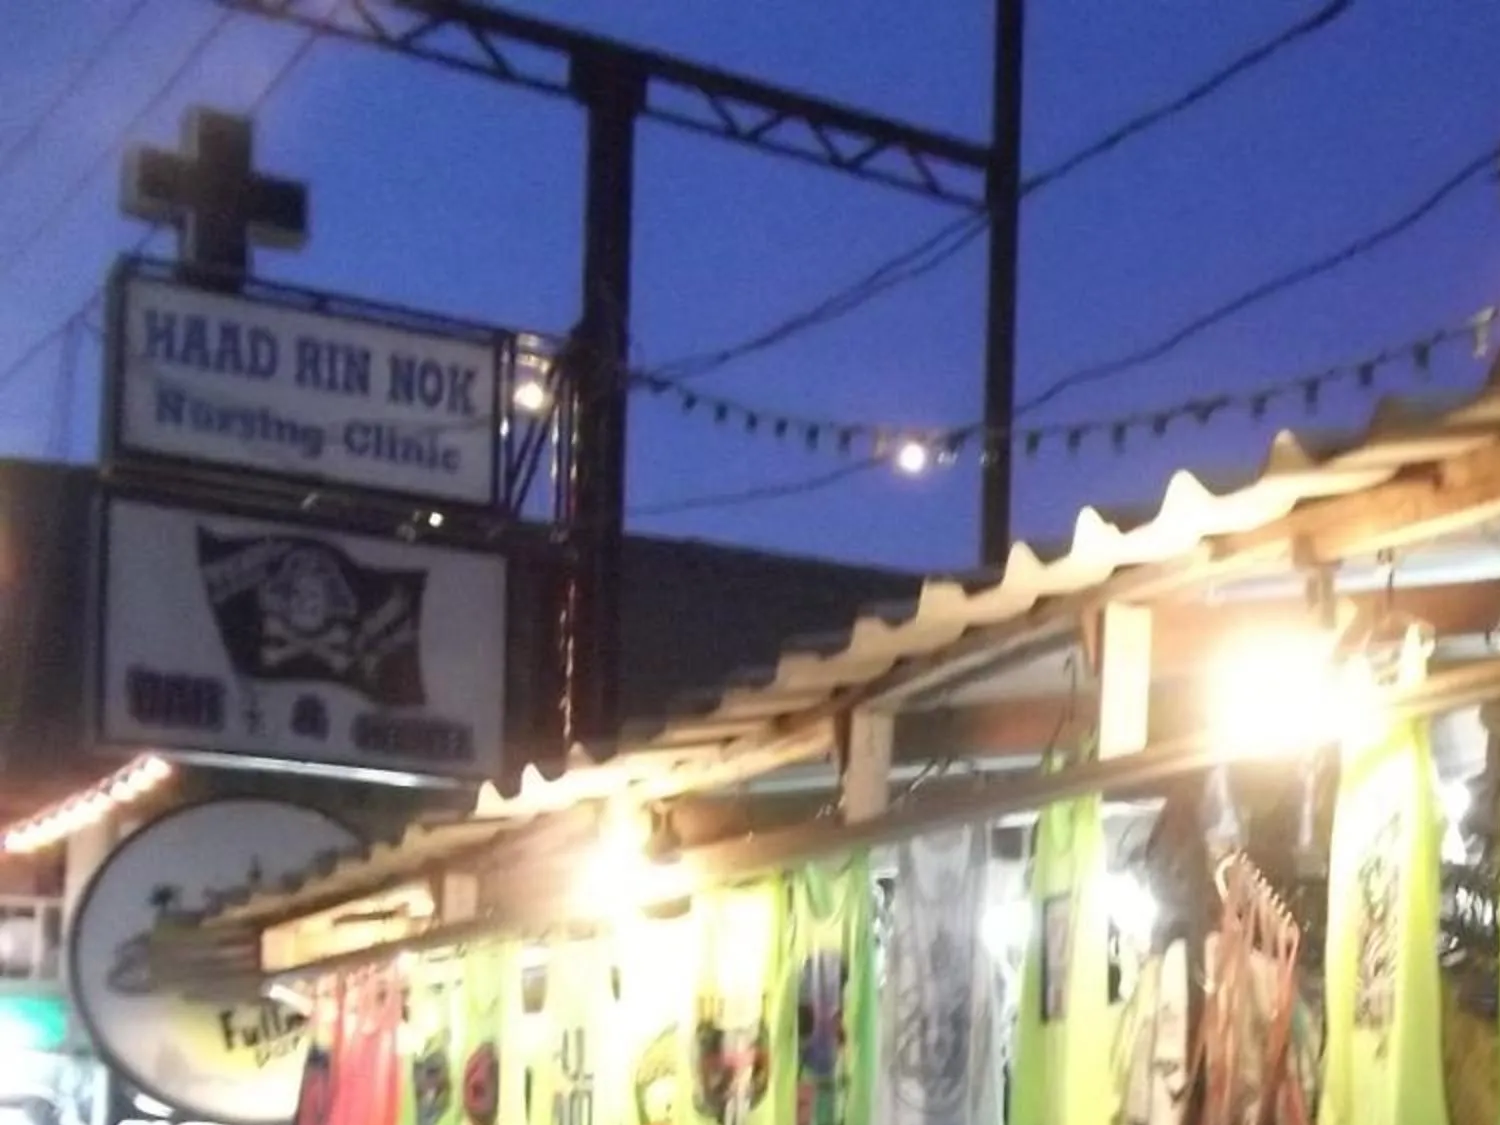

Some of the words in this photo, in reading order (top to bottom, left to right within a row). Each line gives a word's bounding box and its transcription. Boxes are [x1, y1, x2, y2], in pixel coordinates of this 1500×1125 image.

[145, 309, 278, 380] HAAD
[295, 336, 371, 394] RIN
[388, 355, 476, 415] NOK
[343, 420, 461, 472] Clinic
